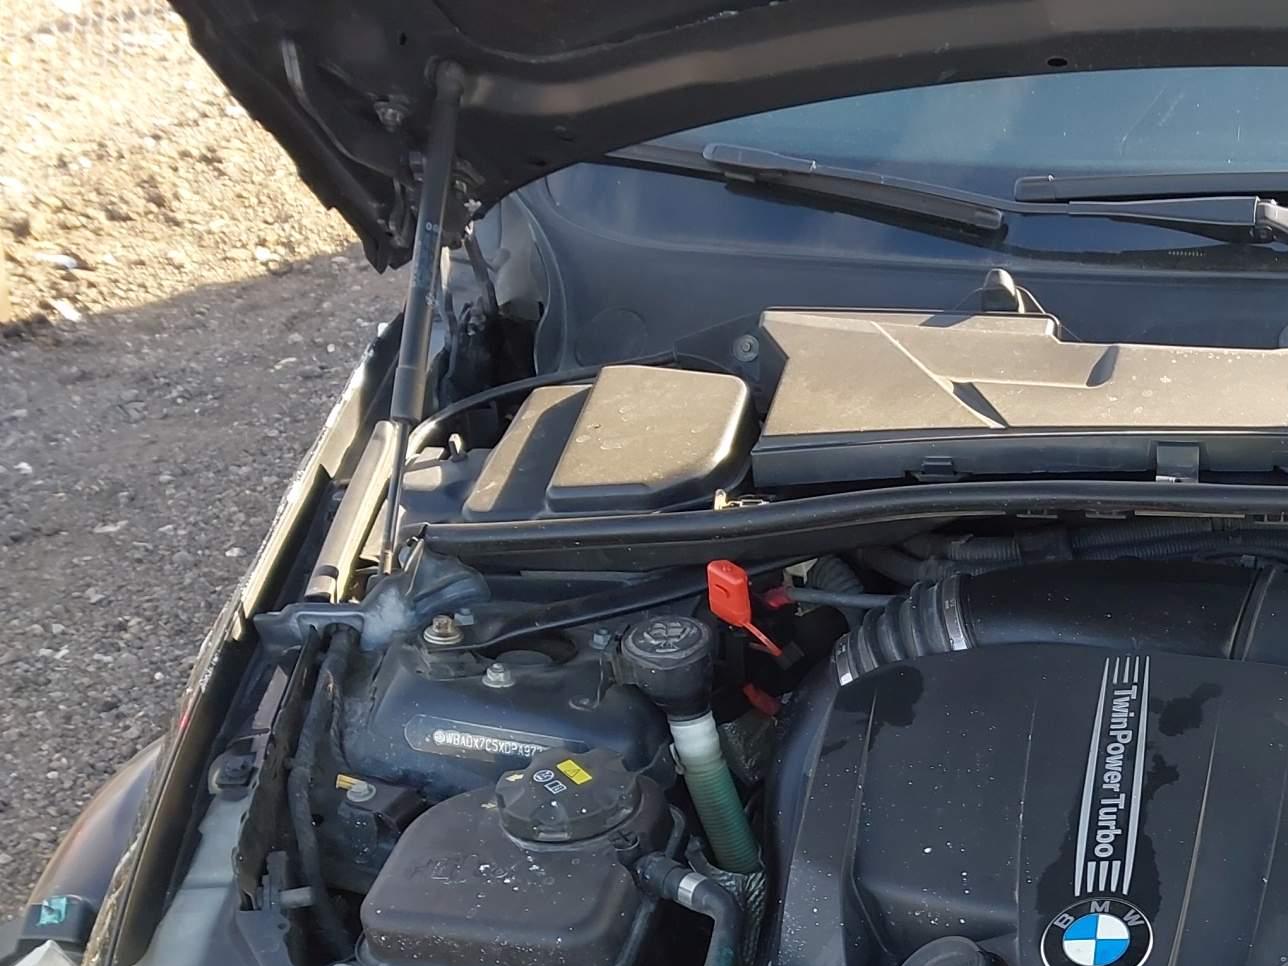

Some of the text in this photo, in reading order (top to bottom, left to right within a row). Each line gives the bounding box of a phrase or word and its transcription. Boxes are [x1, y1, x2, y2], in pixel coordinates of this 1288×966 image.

[1094, 684, 1138, 858] TwinPower Turbo
[1053, 900, 1145, 930] BMW
